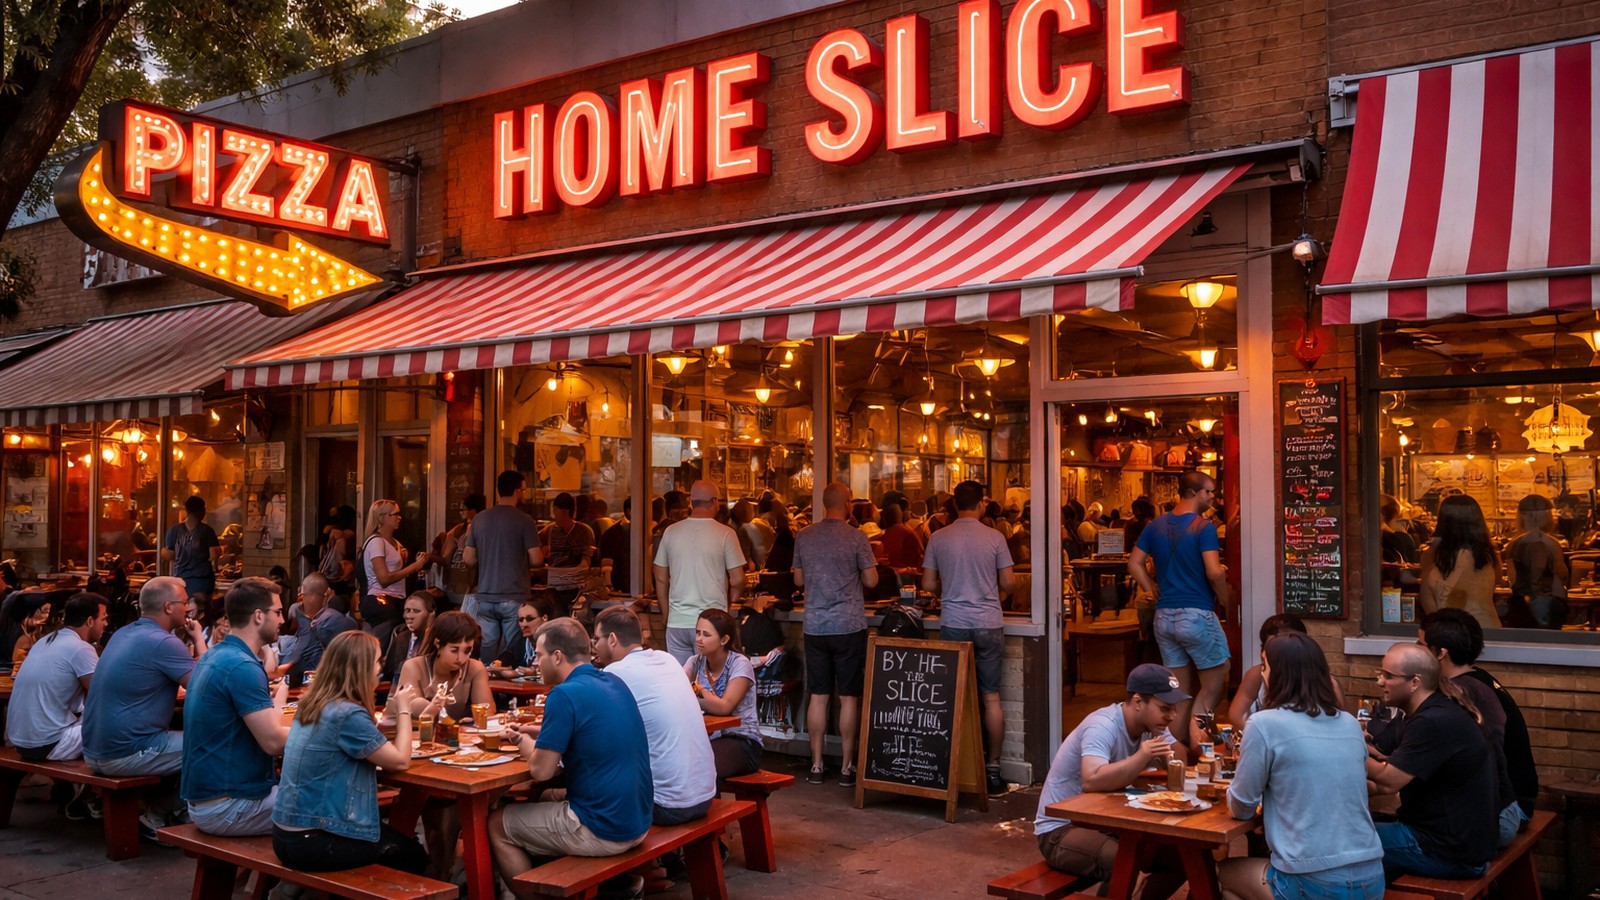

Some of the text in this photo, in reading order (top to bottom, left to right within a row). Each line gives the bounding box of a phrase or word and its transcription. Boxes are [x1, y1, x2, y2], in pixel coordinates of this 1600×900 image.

[494, 0, 1191, 219] HOME SLICE
[124, 106, 388, 239] PIZZA
[882, 651, 908, 671] BY
[885, 680, 947, 705] SLICE
